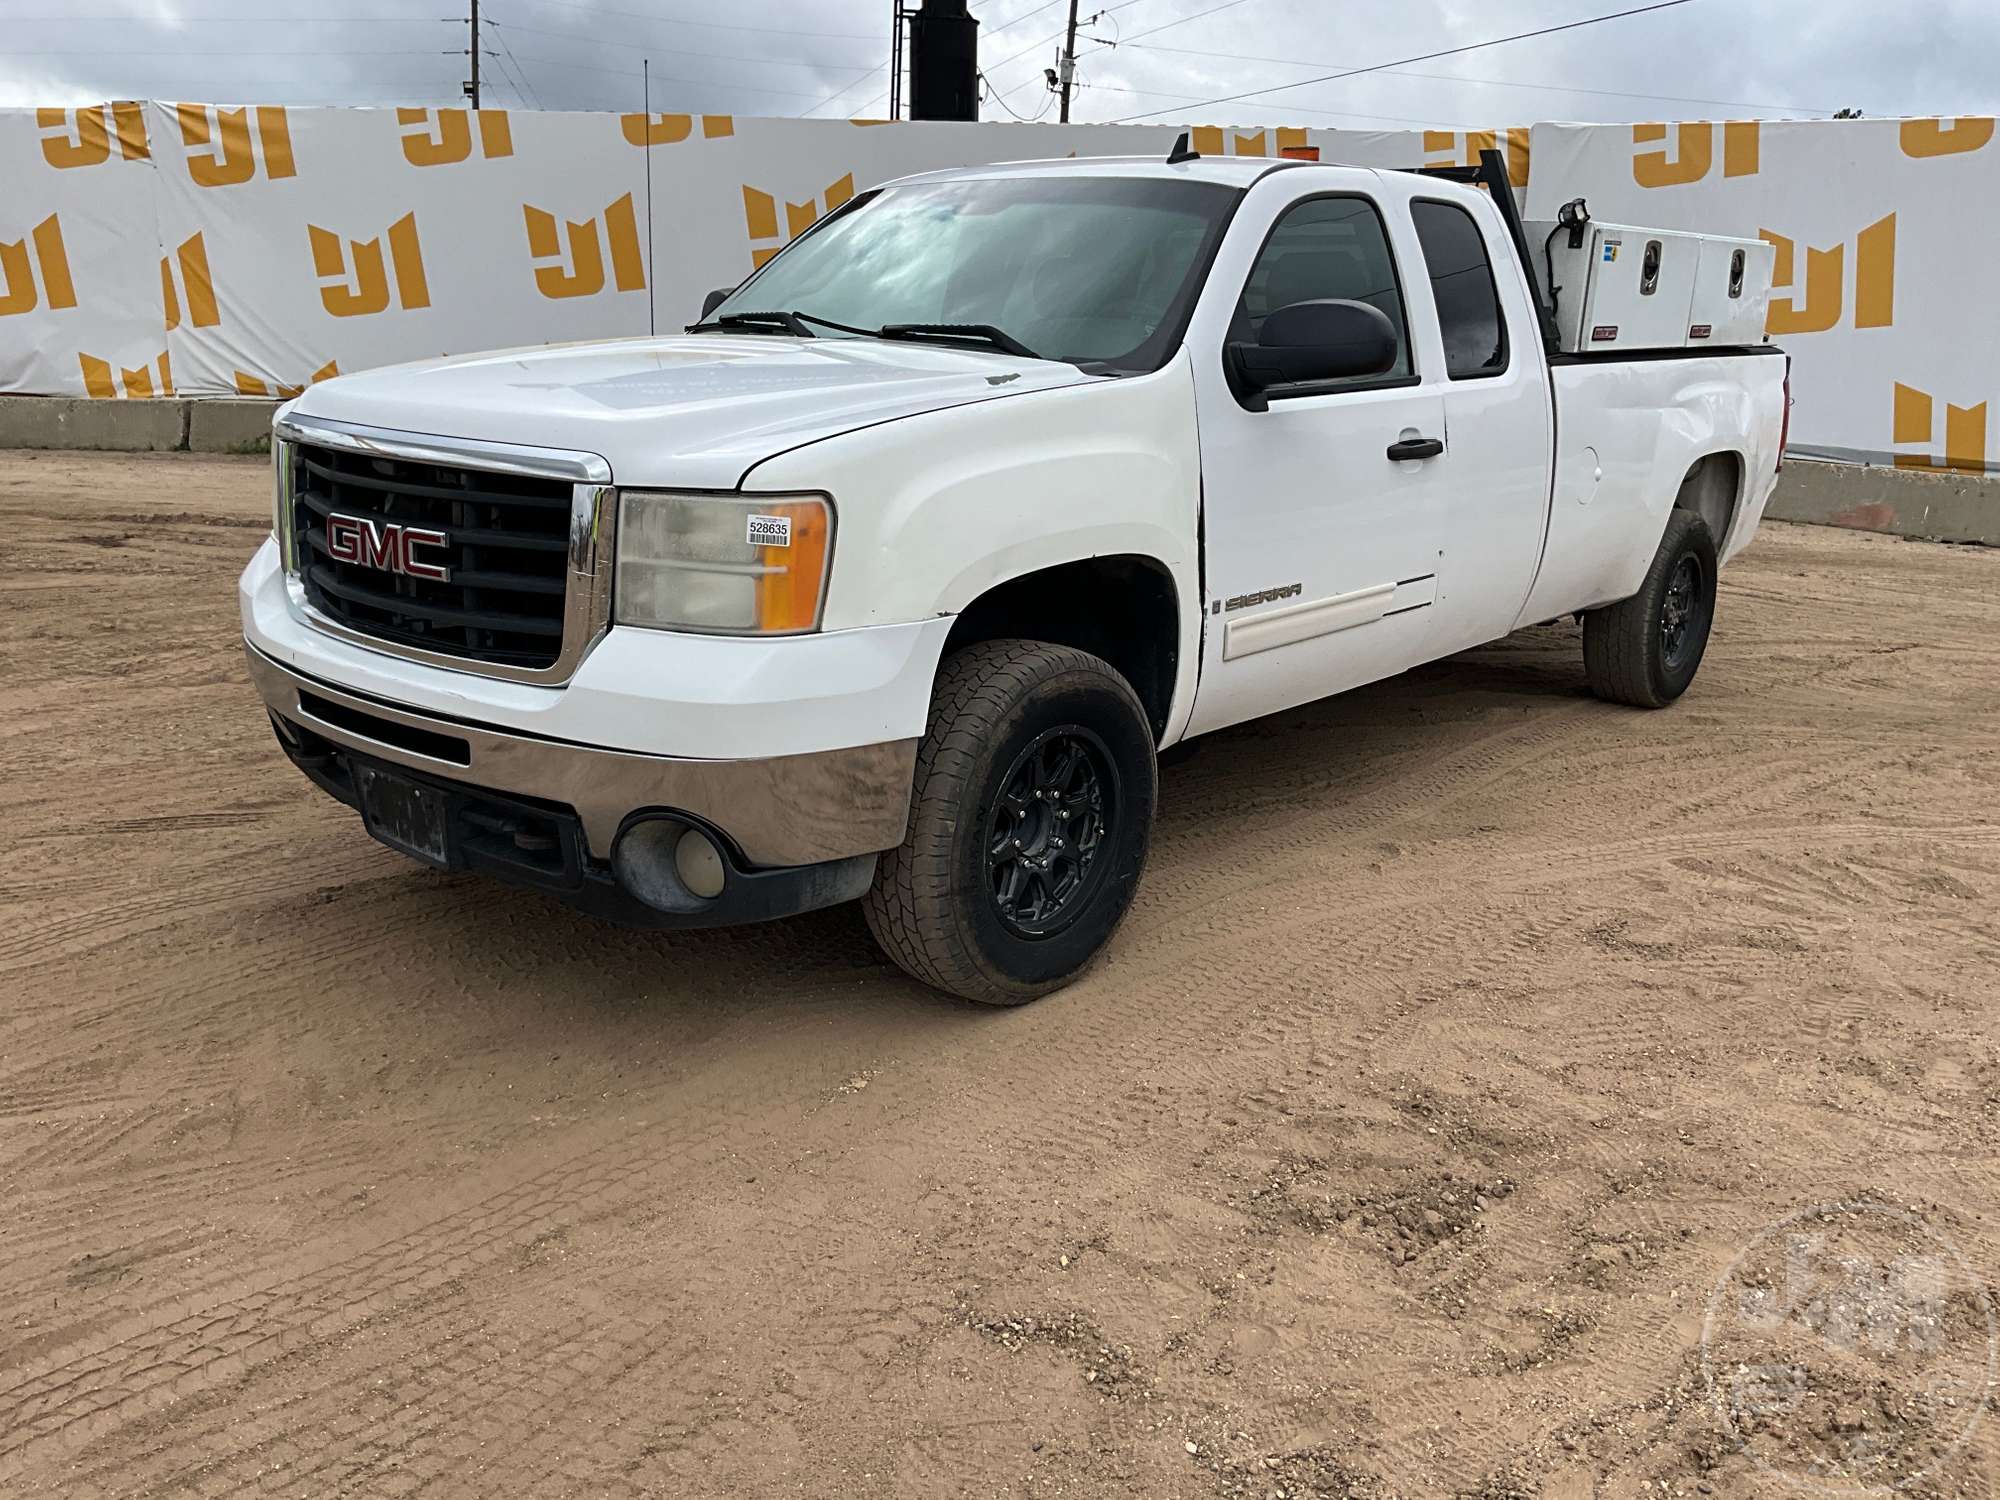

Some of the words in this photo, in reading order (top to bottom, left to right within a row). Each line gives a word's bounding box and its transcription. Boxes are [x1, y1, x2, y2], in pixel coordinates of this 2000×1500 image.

[750, 522, 788, 535] 528635
[327, 512, 450, 582] GMC
[1225, 583, 1302, 612] SIERRA
